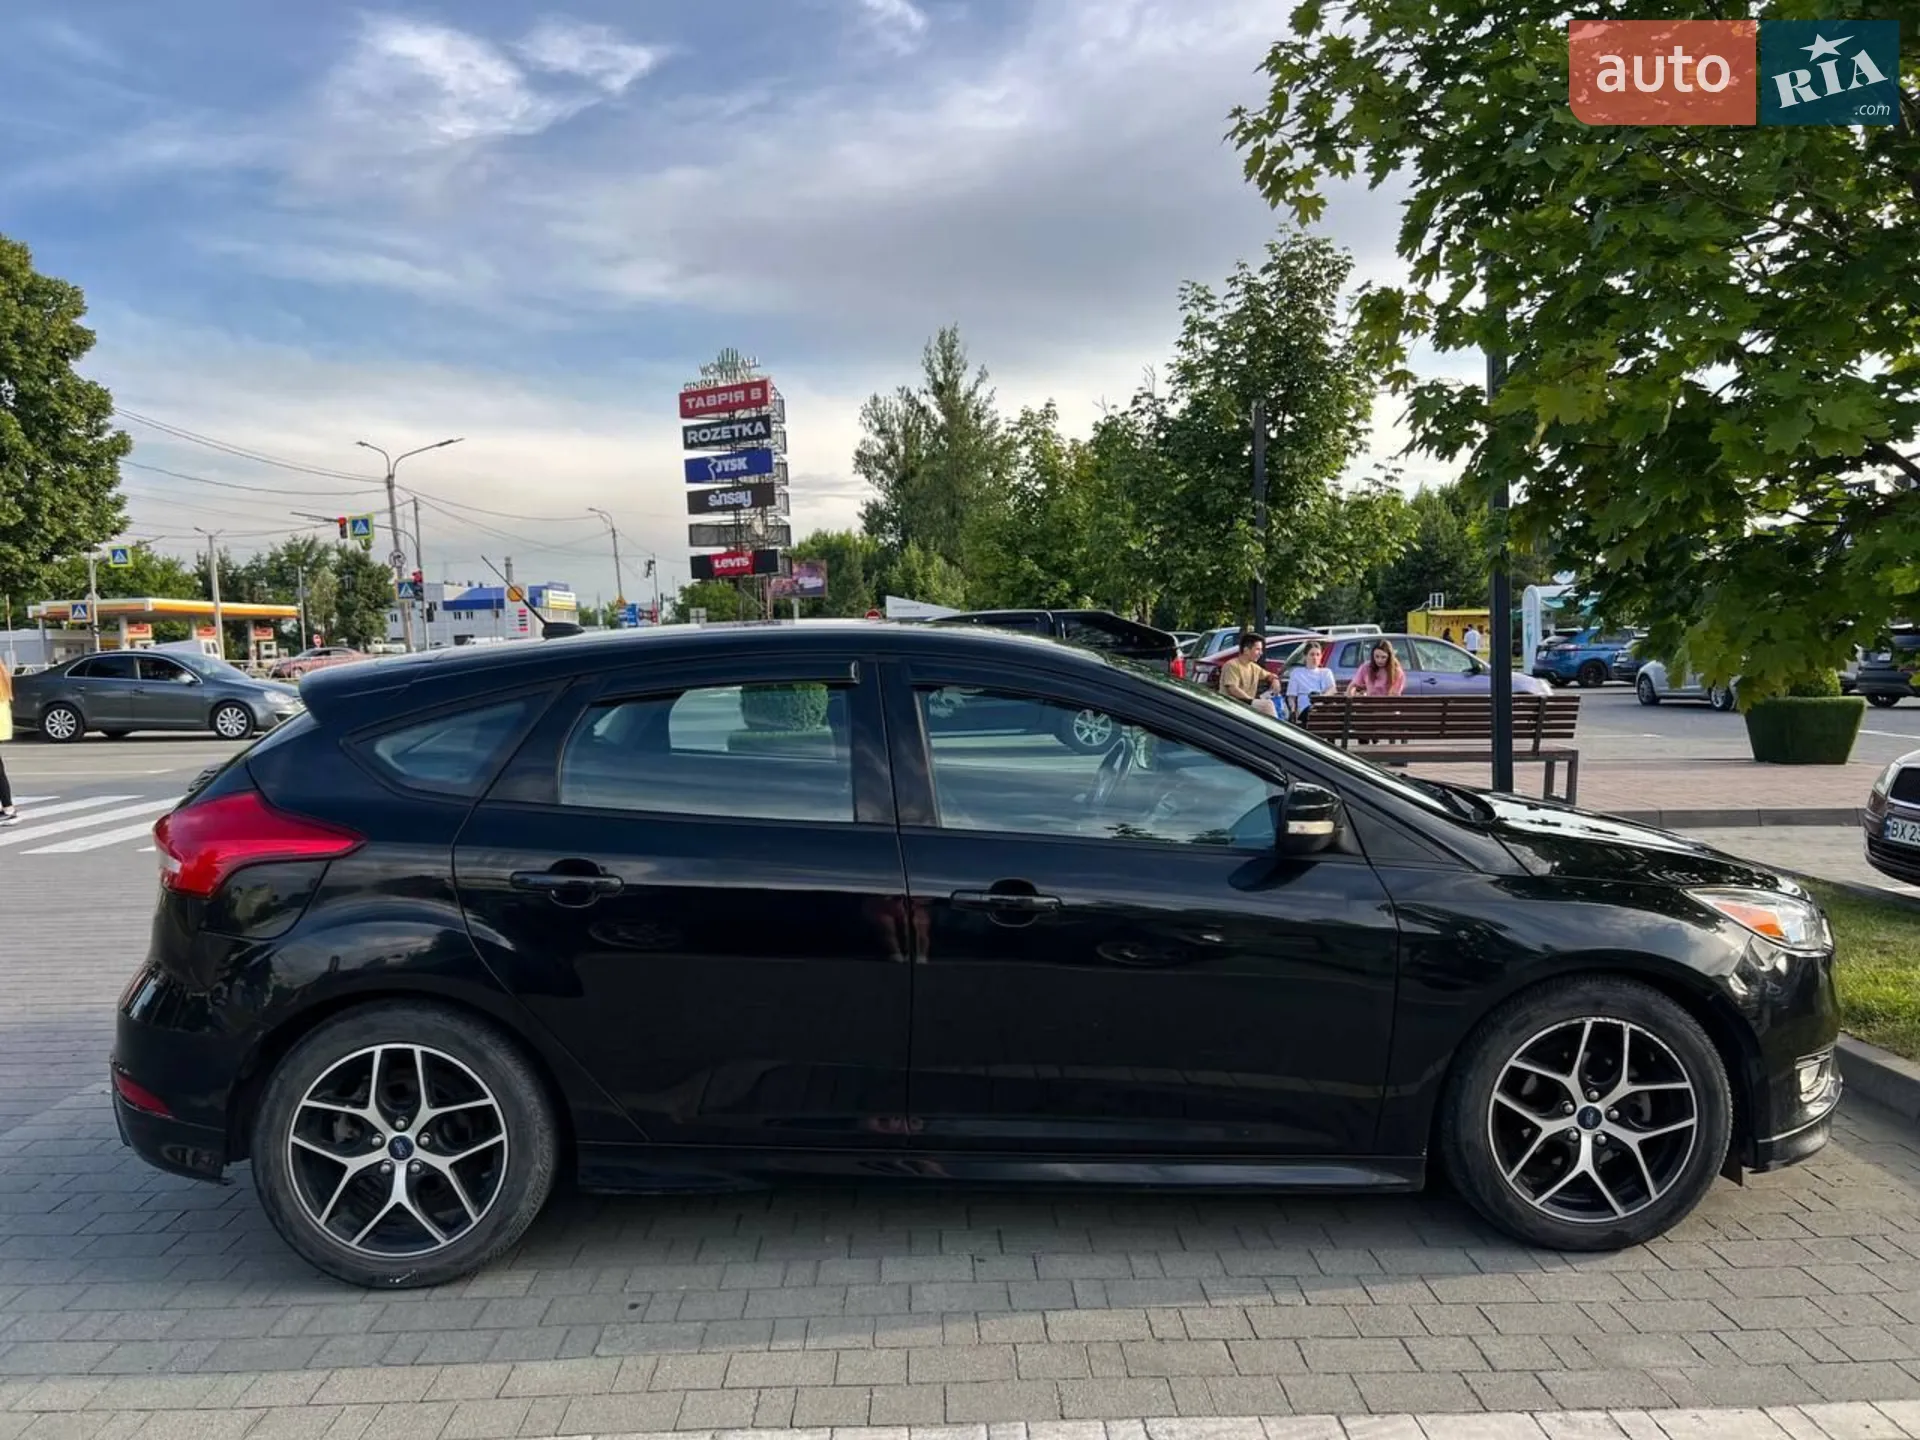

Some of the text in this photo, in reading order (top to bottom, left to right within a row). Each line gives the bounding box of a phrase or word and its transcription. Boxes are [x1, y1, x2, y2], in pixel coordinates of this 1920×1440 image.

[685, 387, 762, 409] ТАВРІЯ В
[686, 421, 767, 444] ROZETKA
[715, 457, 748, 473] JYSK
[707, 490, 752, 508] sinsay
